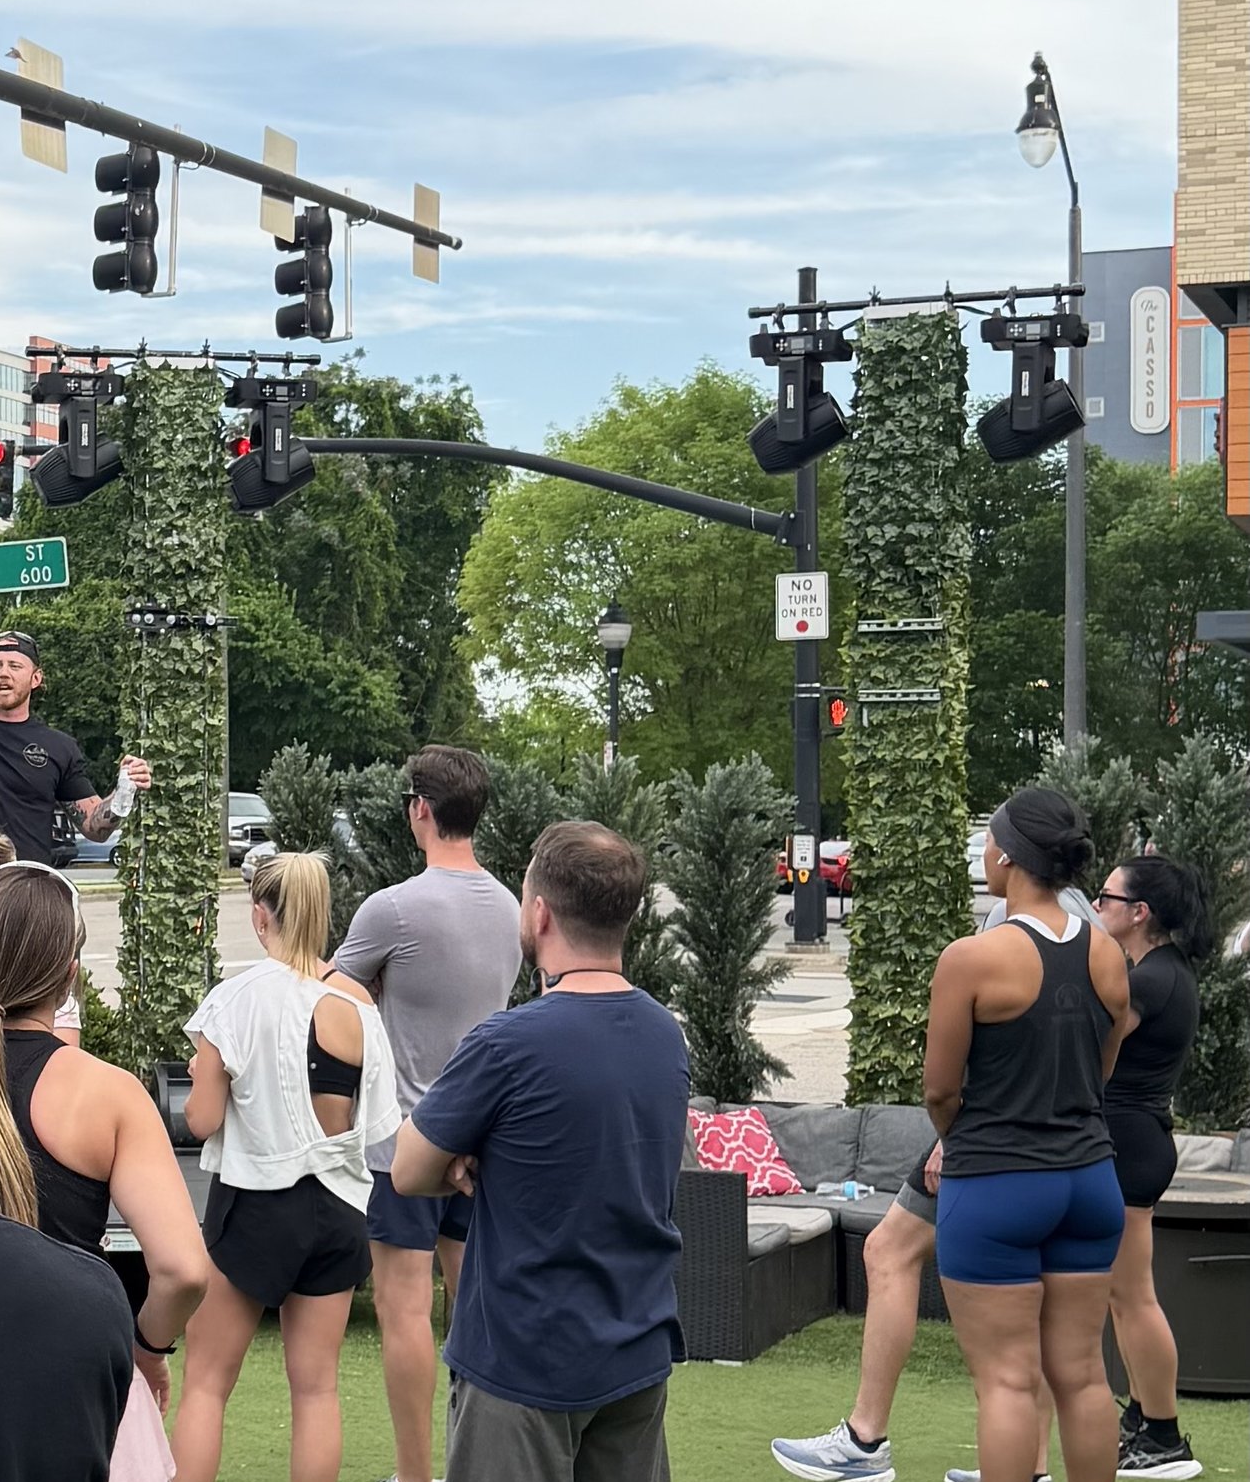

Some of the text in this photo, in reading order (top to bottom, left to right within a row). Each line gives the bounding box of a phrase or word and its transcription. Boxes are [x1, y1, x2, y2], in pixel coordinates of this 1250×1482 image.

[1146, 315, 1155, 419] CASSO
[25, 544, 45, 562] ST
[20, 565, 52, 585] 600
[791, 579, 813, 591] NO
[788, 593, 817, 605] TURN
[781, 607, 823, 618] ON RED
